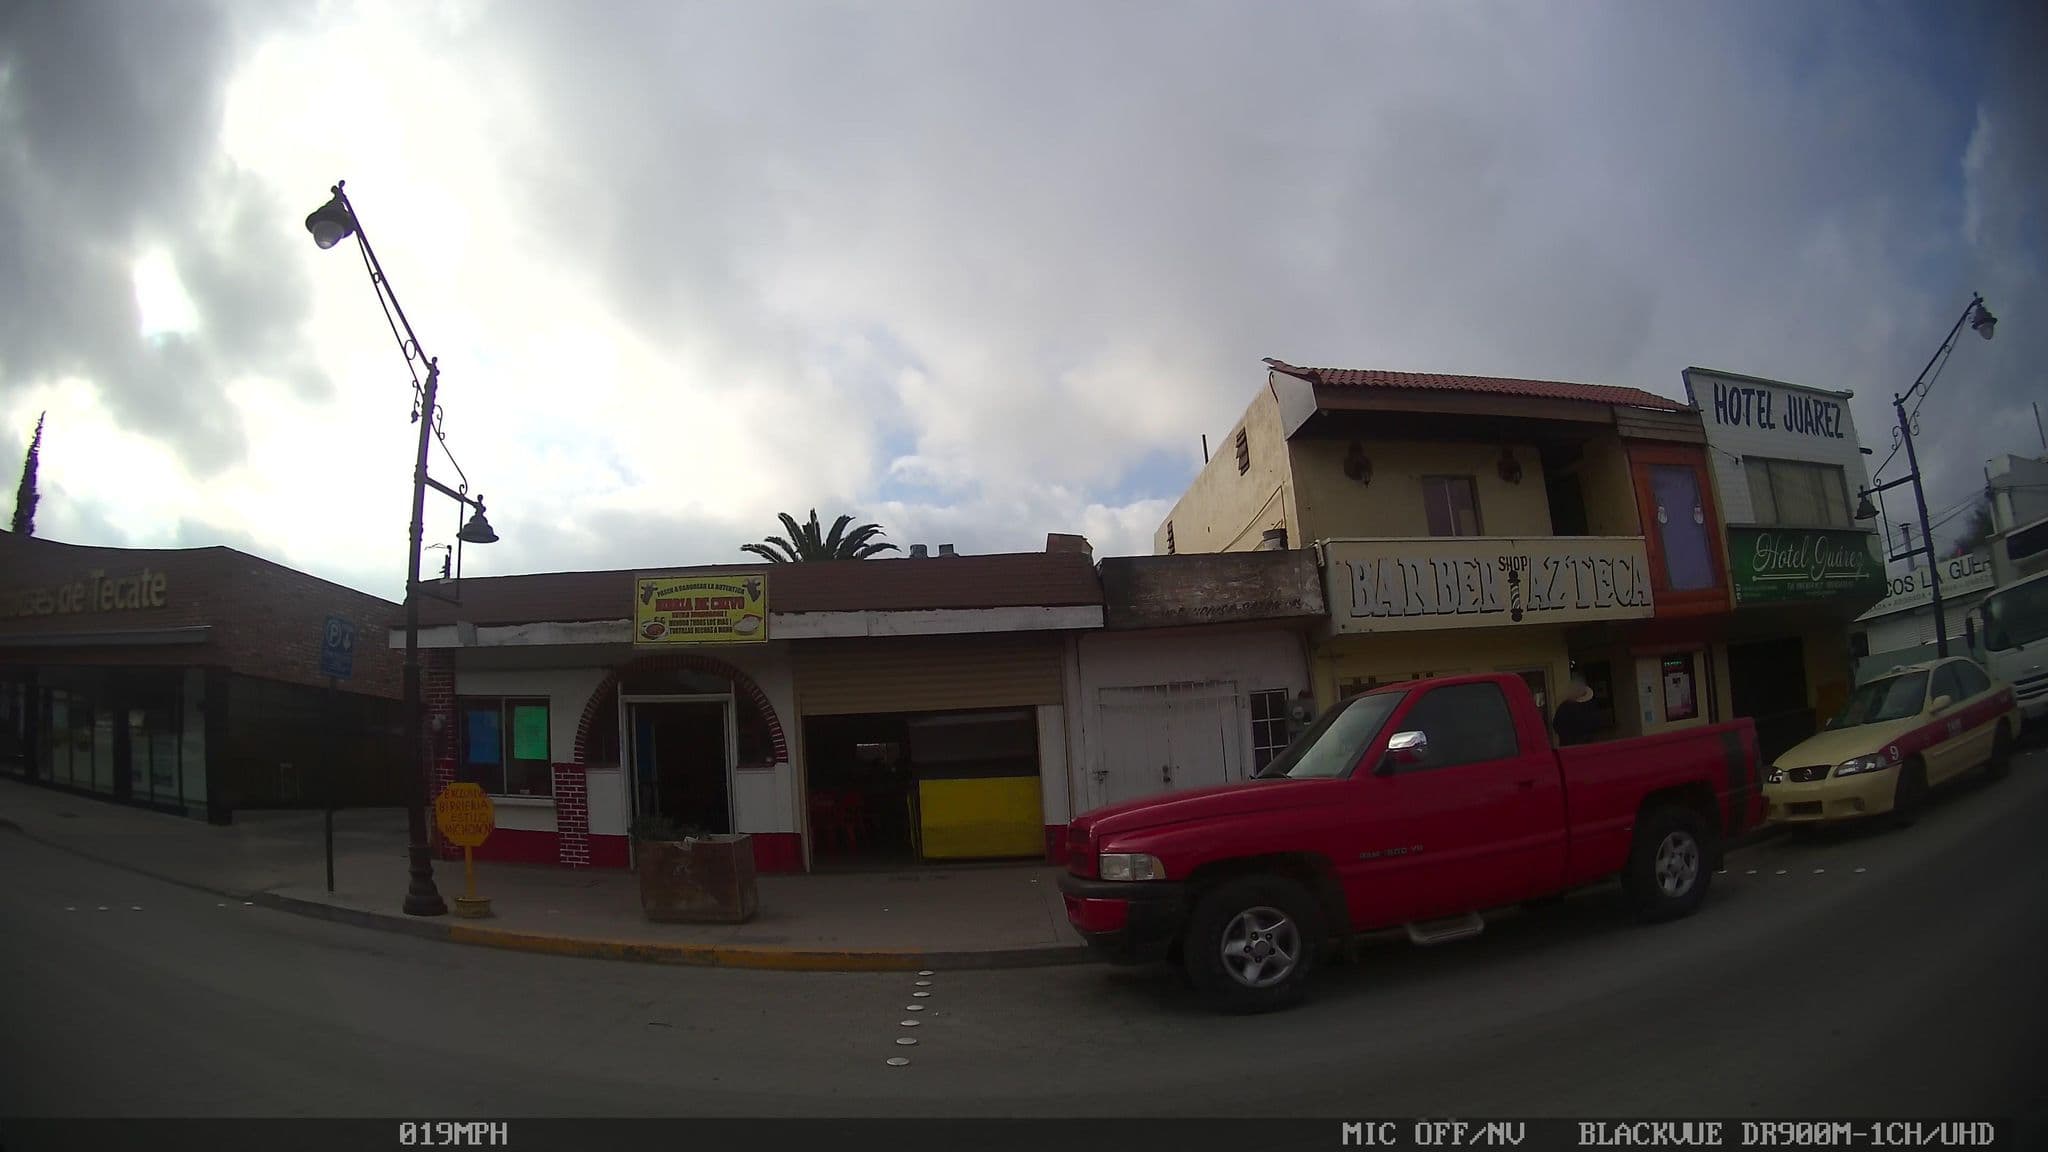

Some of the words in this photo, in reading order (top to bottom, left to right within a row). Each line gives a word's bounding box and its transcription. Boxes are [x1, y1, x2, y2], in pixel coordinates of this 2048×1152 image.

[1714, 382, 1776, 430] HOTEL
[1783, 395, 1844, 439] JUÁREZ
[1498, 556, 1528, 571] SHOP
[1752, 532, 1810, 572] Hotel
[89, 567, 167, 612] Tecate
[1346, 556, 1504, 618] BARBER
[1526, 555, 1651, 612] AZTECA
[1889, 745, 1900, 761] 9
